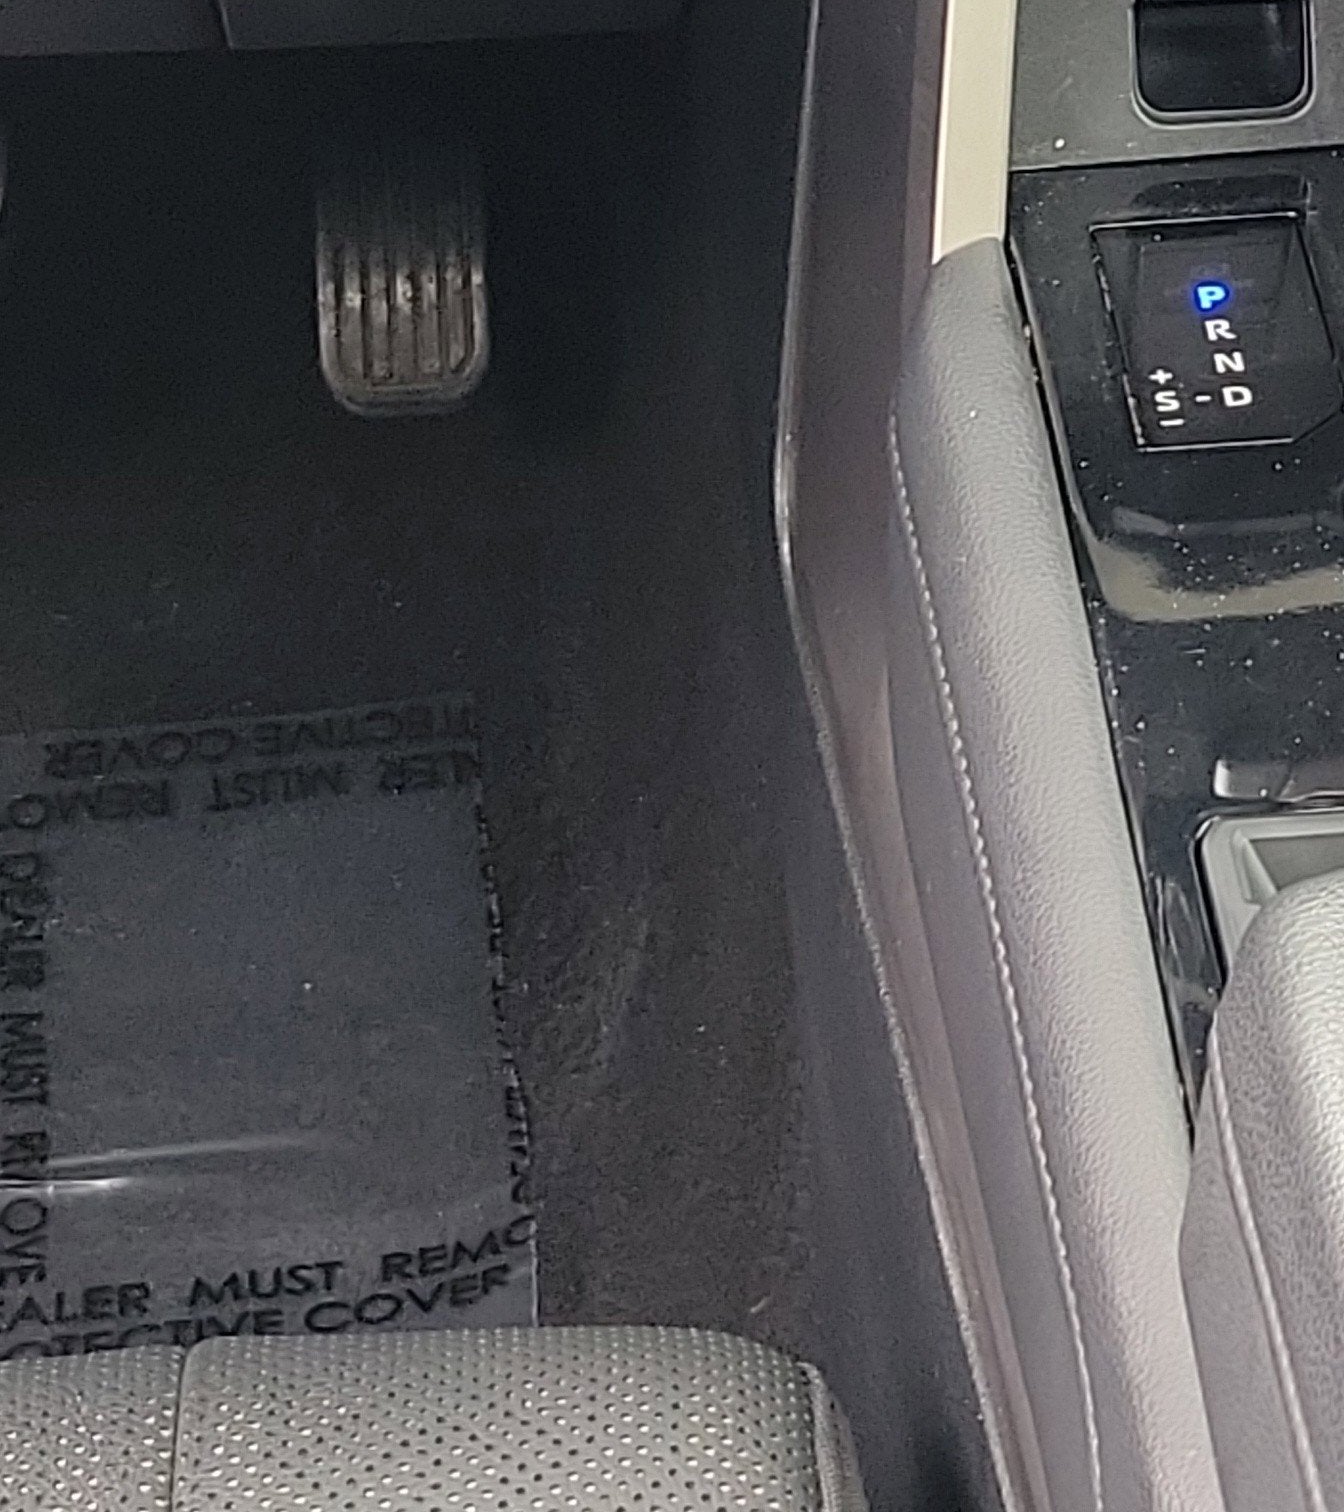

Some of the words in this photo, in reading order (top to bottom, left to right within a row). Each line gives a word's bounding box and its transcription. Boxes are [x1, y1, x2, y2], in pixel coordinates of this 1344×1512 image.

[1196, 285, 1226, 310] P
[1204, 319, 1237, 342] R
[1213, 351, 1246, 374] N
[1154, 390, 1181, 412] S
[1221, 385, 1253, 408] D
[188, 1260, 345, 1307] MUST
